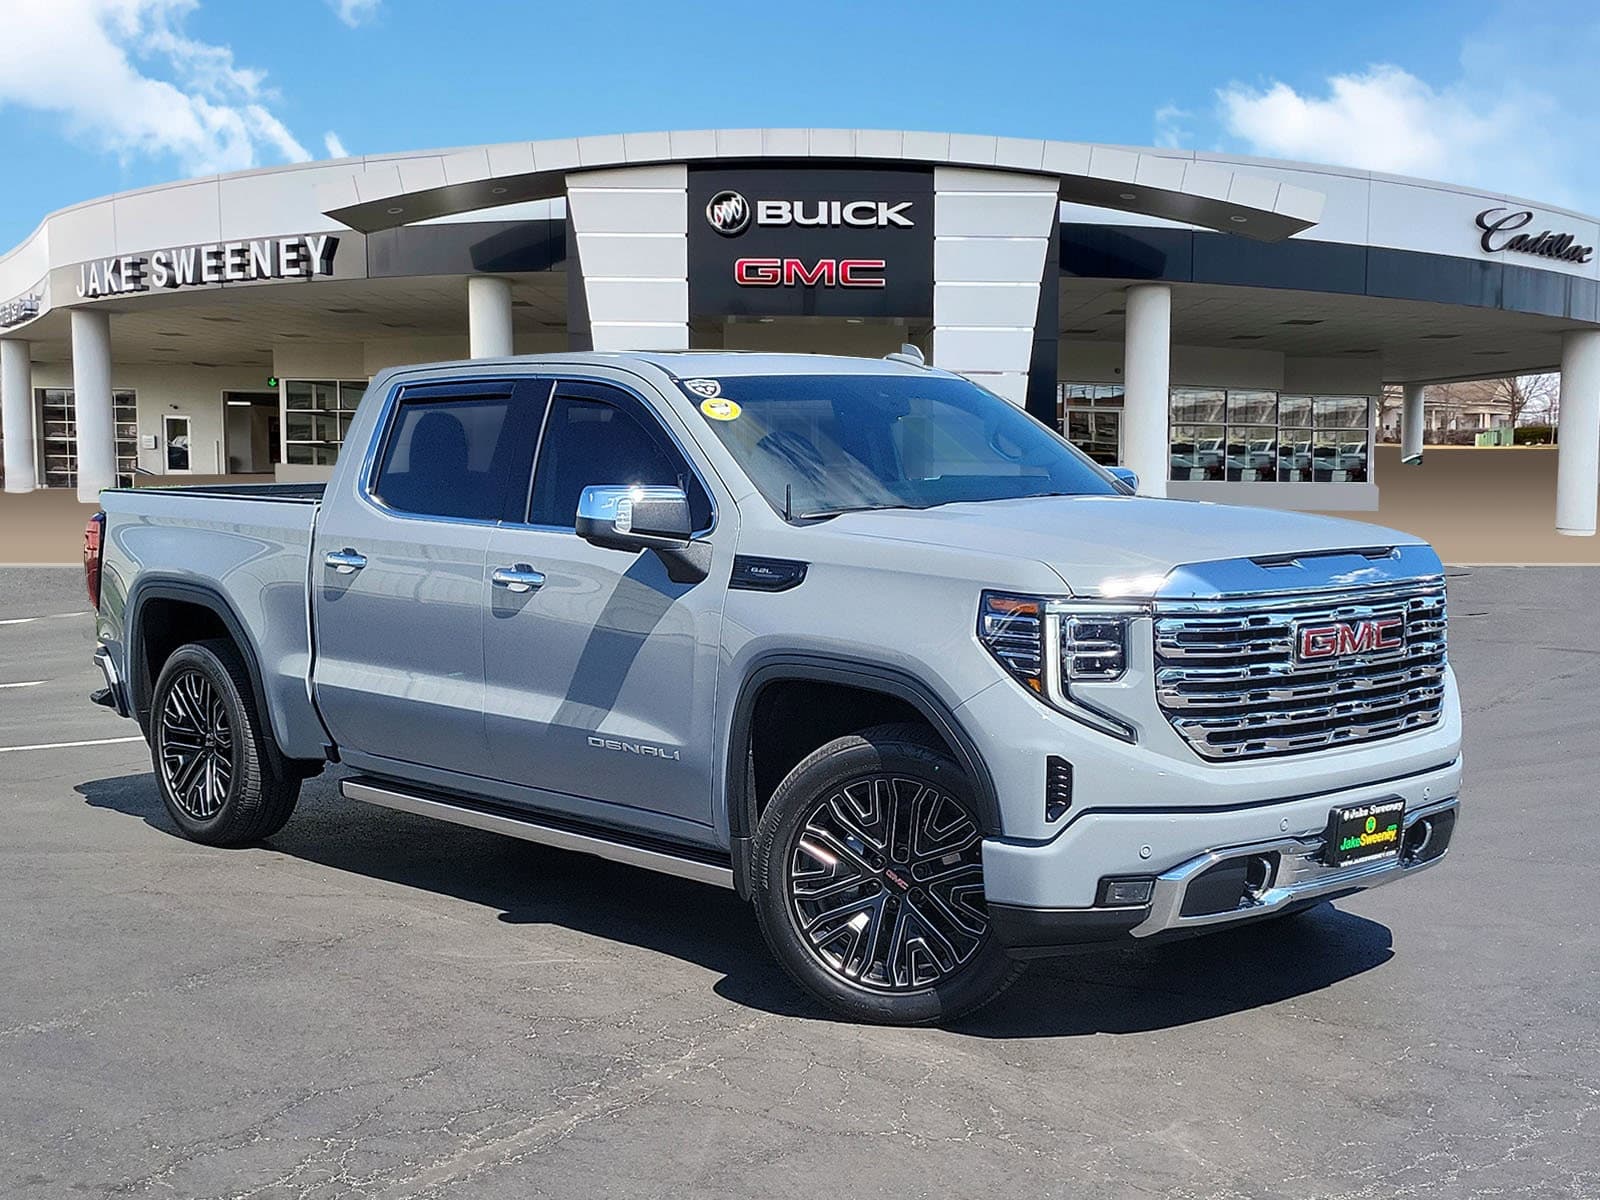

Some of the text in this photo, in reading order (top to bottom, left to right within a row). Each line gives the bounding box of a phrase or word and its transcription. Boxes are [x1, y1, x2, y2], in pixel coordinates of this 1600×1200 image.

[757, 200, 915, 226] BUICK
[1475, 207, 1594, 264] Cadillac
[76, 235, 332, 298] JAKE SWEENEY
[735, 257, 886, 287] GMC
[1300, 617, 1402, 659] GMC
[587, 736, 680, 761] DENALI
[1350, 801, 1404, 820] Jake Sweeney
[885, 869, 909, 890] GMC
